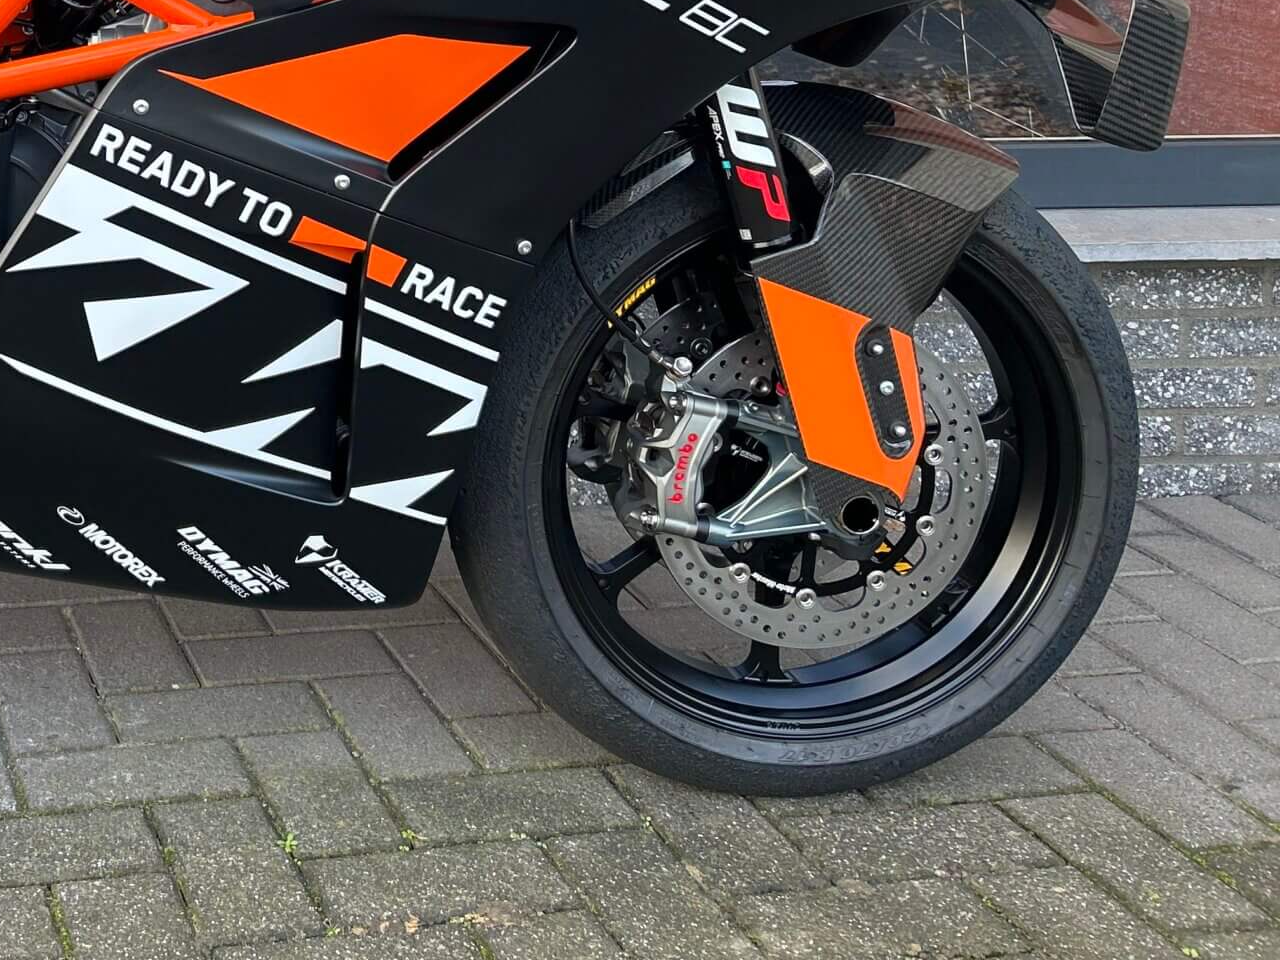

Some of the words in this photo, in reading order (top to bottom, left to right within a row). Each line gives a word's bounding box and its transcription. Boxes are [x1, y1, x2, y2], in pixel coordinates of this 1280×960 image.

[706, 104, 725, 142] APEX
[89, 123, 236, 209] READY
[237, 188, 294, 238] TO
[400, 262, 508, 329] RACE
[607, 275, 656, 328] YMAG
[666, 432, 699, 504] brembo
[78, 522, 166, 588] MOTOREX
[176, 525, 270, 595] DYMAG
[176, 541, 221, 581] PERFORMANCE
[220, 573, 250, 599] WHEELS
